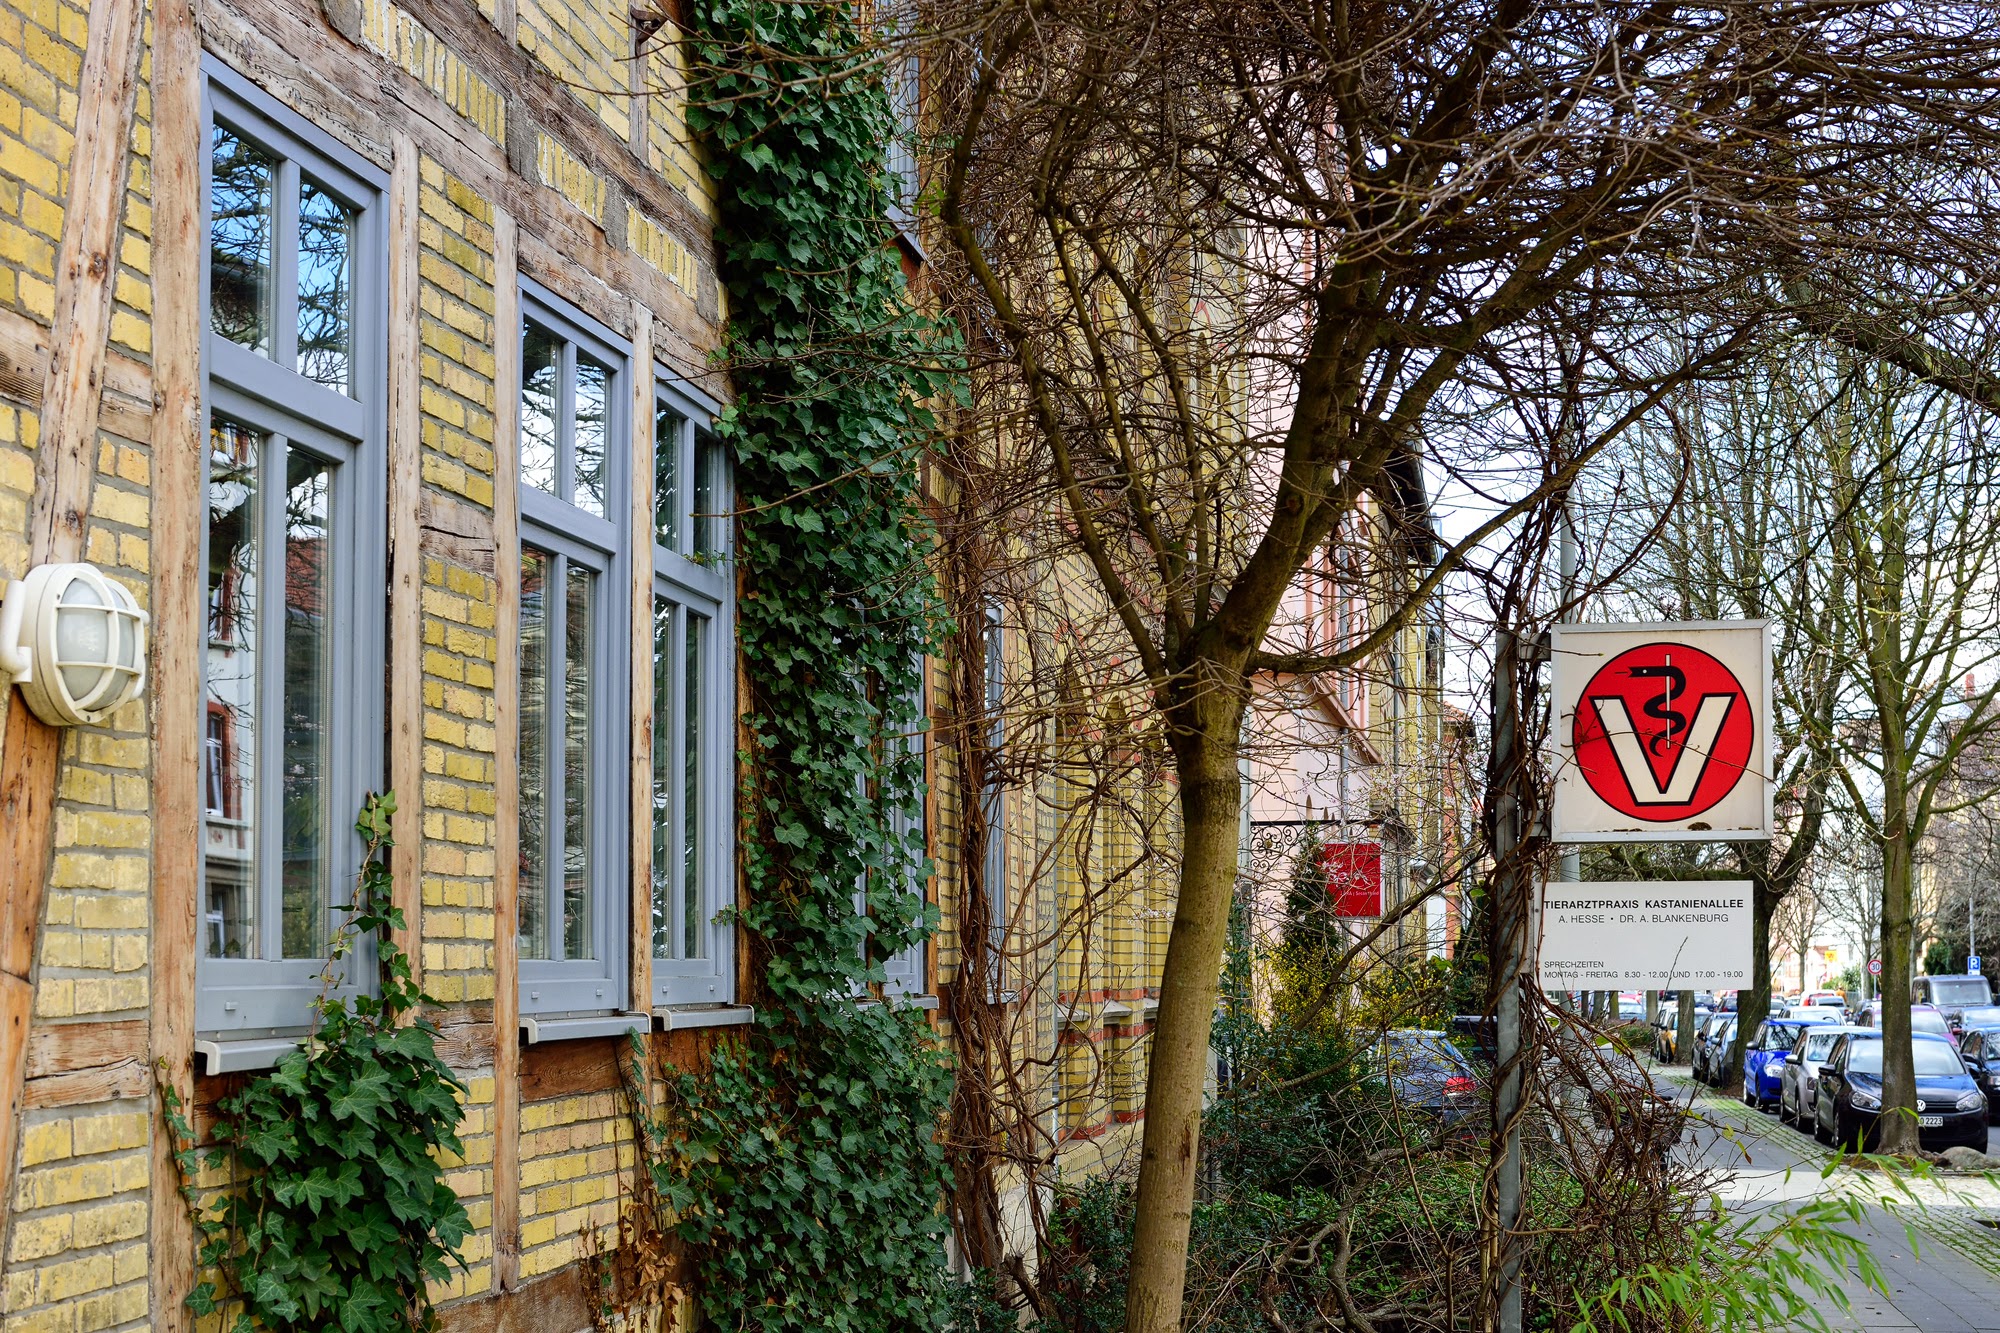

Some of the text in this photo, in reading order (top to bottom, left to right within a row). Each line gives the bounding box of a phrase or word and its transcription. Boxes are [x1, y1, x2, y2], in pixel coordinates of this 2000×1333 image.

[1588, 692, 1738, 807] V
[1544, 899, 1744, 909] TIERARZTPRAXIS KASTANIENALLEE
[1558, 914, 1568, 923] A.
[1571, 914, 1605, 924] HESSE
[1619, 914, 1637, 923] DR.
[1639, 914, 1649, 923] A.
[1652, 913, 1729, 923] BLANKENBURG
[1544, 960, 1604, 968] SPRECHZEITEN
[1871, 962, 1880, 971] 30
[1544, 971, 1579, 979] MONTAG
[1585, 971, 1619, 979] FREITAG
[1723, 970, 1744, 978] 19.00
[1925, 1117, 1943, 1126] 2223
